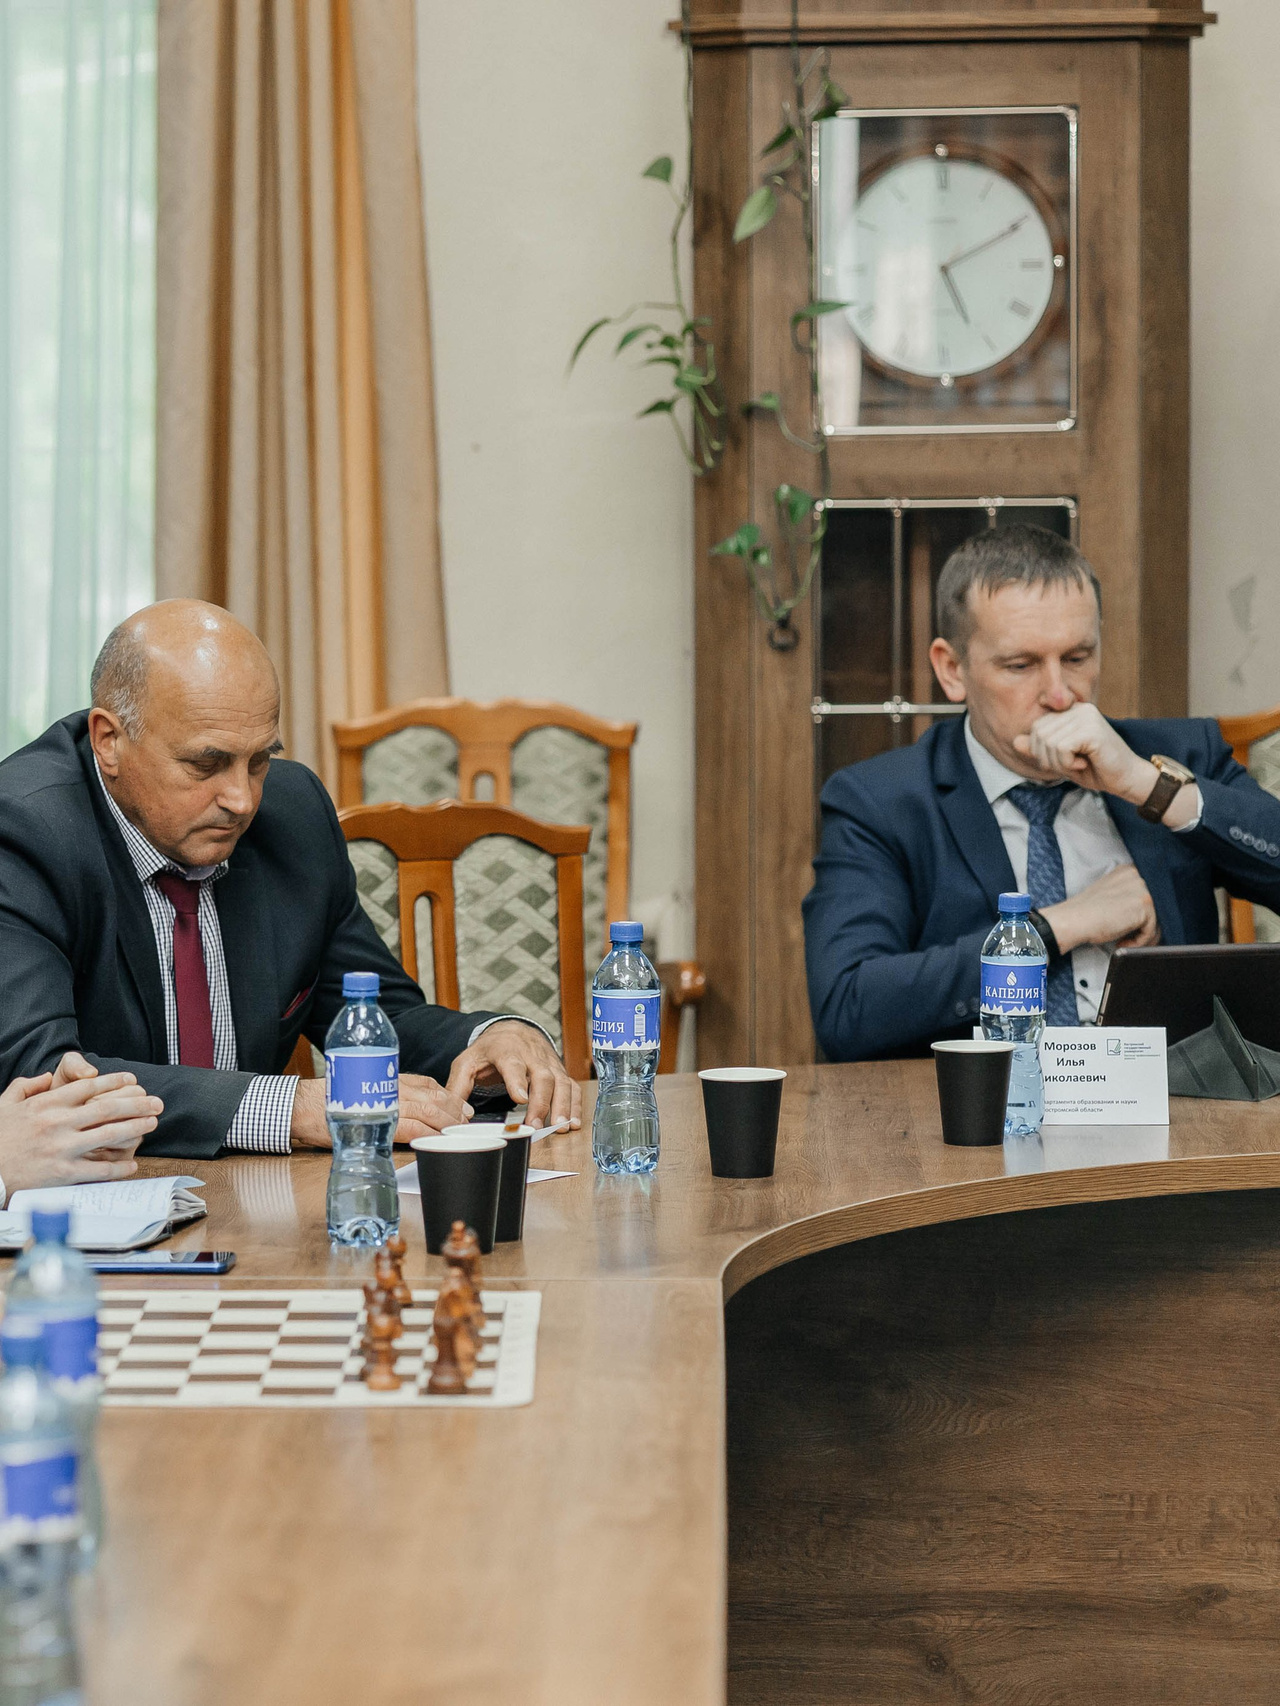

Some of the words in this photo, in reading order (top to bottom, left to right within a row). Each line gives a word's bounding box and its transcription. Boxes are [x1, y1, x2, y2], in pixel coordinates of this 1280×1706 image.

[985, 985, 1039, 999] КАПЕЛИЯ
[1044, 1042, 1096, 1052] Морозов
[1056, 1057, 1085, 1067] Илья
[1044, 1074, 1106, 1083] иколаевич
